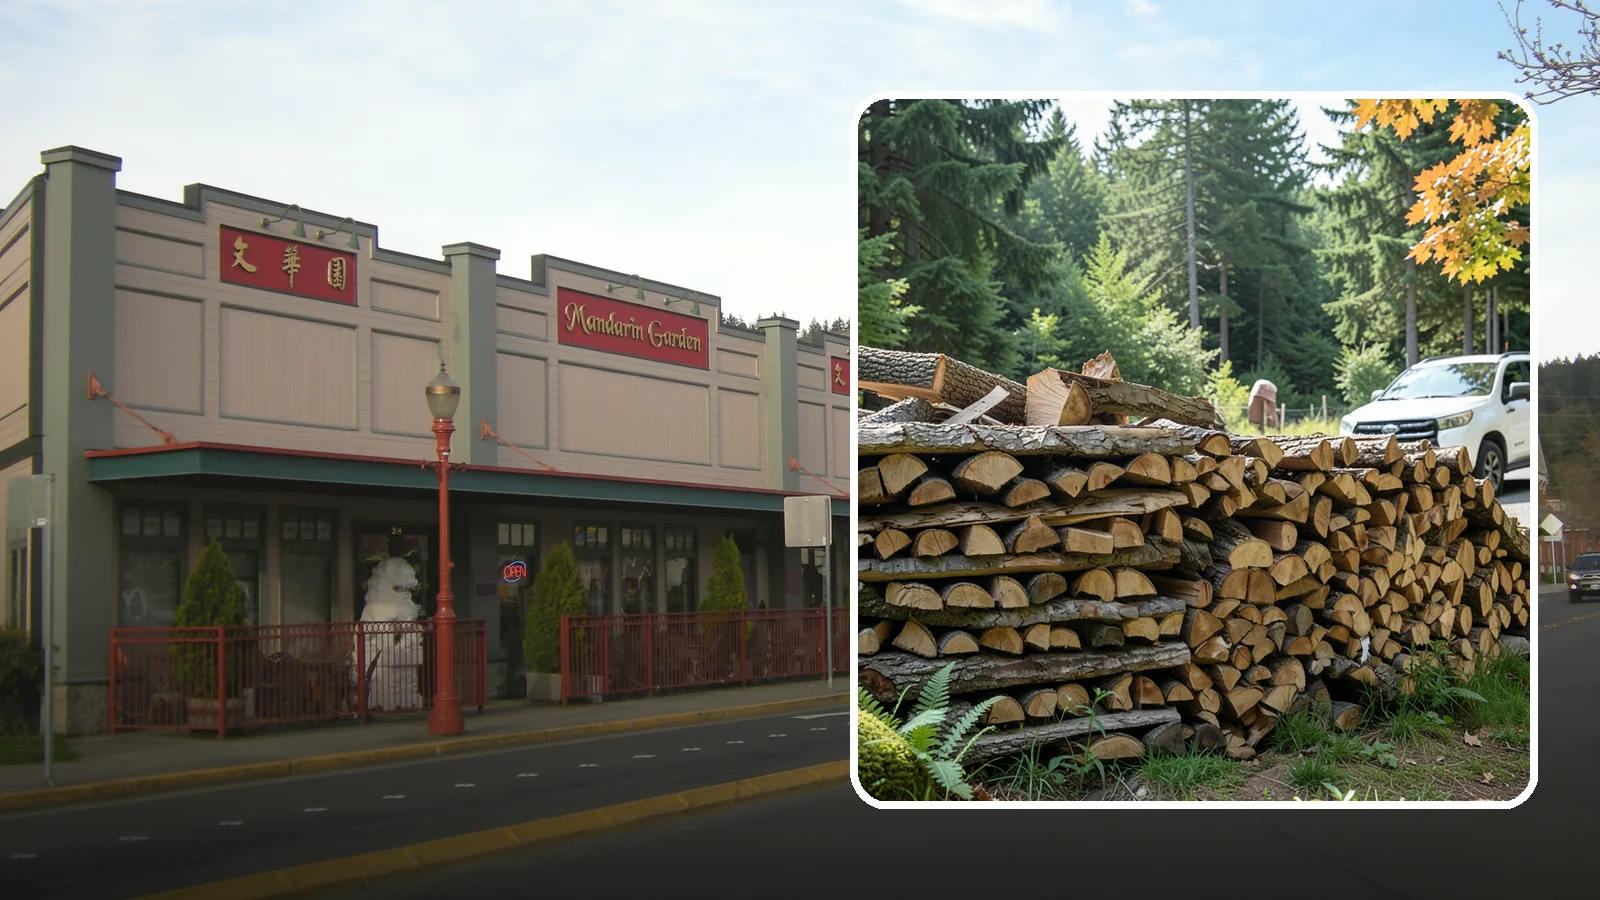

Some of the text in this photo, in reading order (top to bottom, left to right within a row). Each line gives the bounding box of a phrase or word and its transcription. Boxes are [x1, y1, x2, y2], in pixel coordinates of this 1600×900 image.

[231, 235, 346, 291] 文華園
[565, 302, 701, 352] Mandarin Garden
[504, 565, 526, 578] OPEN
